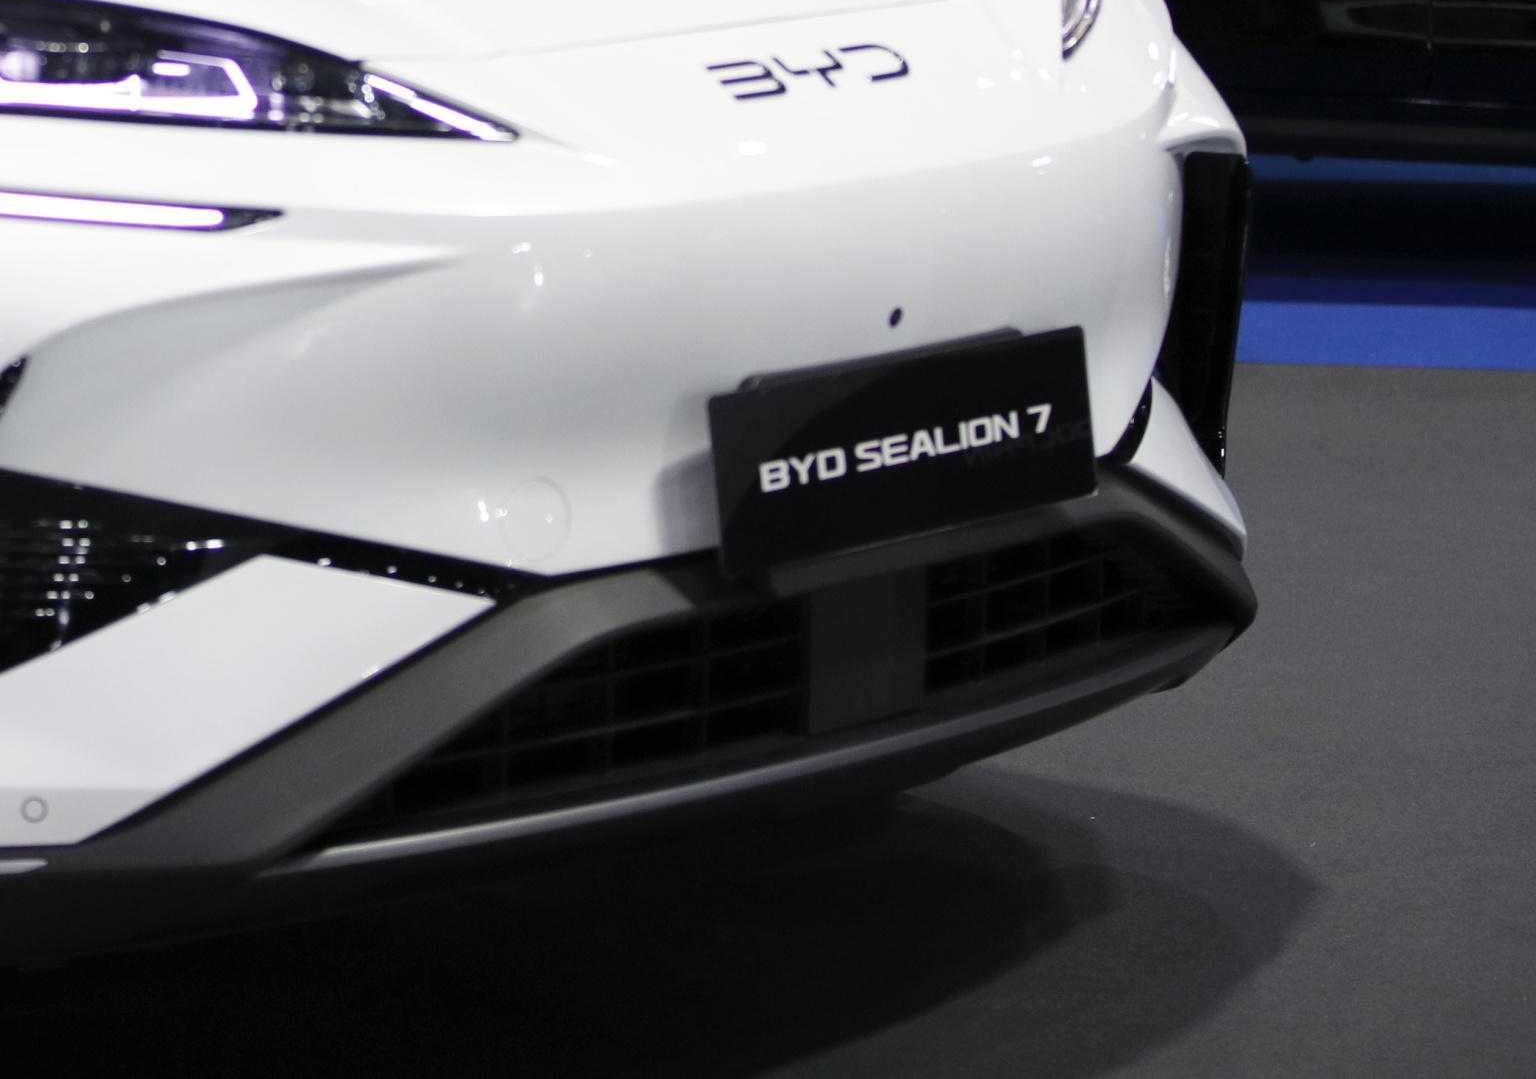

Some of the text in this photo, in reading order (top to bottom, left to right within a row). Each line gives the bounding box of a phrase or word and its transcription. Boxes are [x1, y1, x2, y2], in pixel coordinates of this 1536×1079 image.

[706, 43, 910, 101] BYD
[759, 403, 1052, 493] BYD SEALION 7
